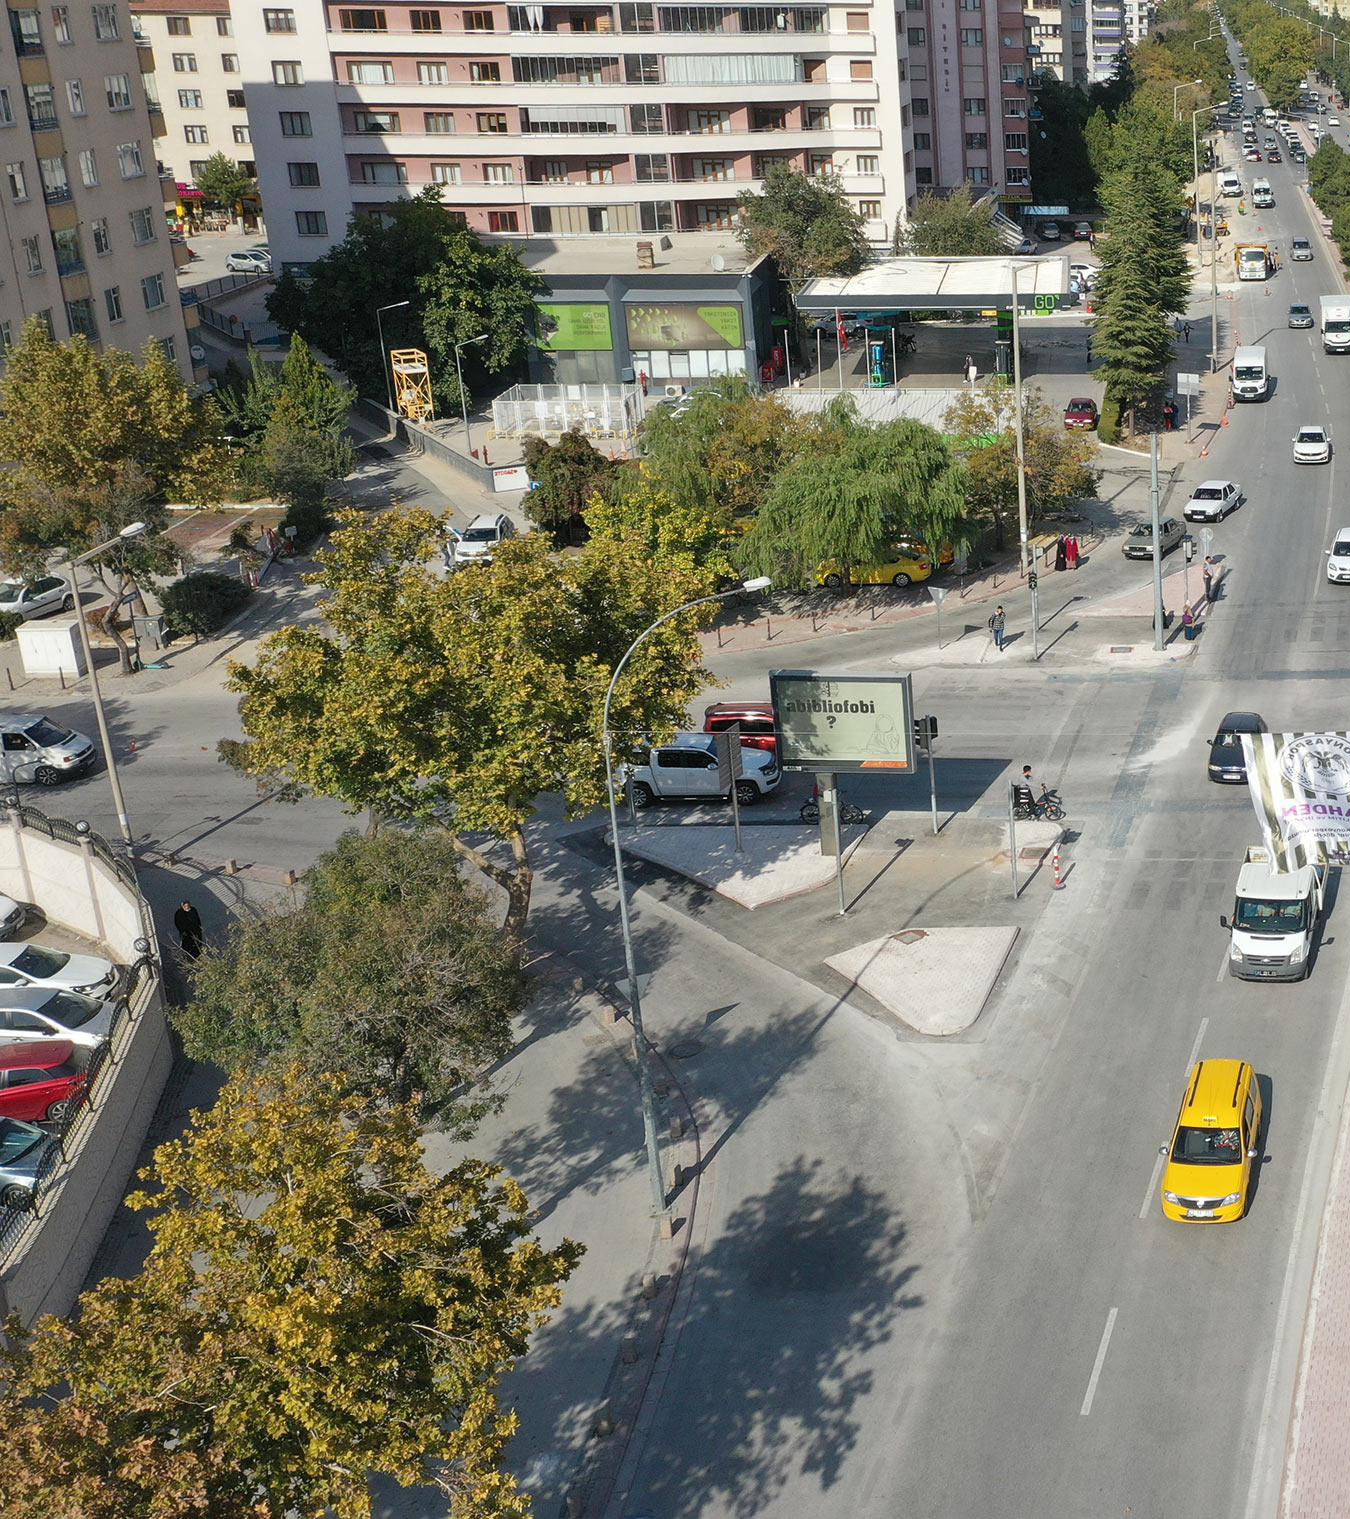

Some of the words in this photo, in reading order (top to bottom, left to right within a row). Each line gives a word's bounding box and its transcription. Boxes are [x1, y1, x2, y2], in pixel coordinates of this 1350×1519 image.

[1034, 294, 1055, 309] GO
[786, 700, 876, 714] abibliofobi
[826, 715, 837, 729] ?
